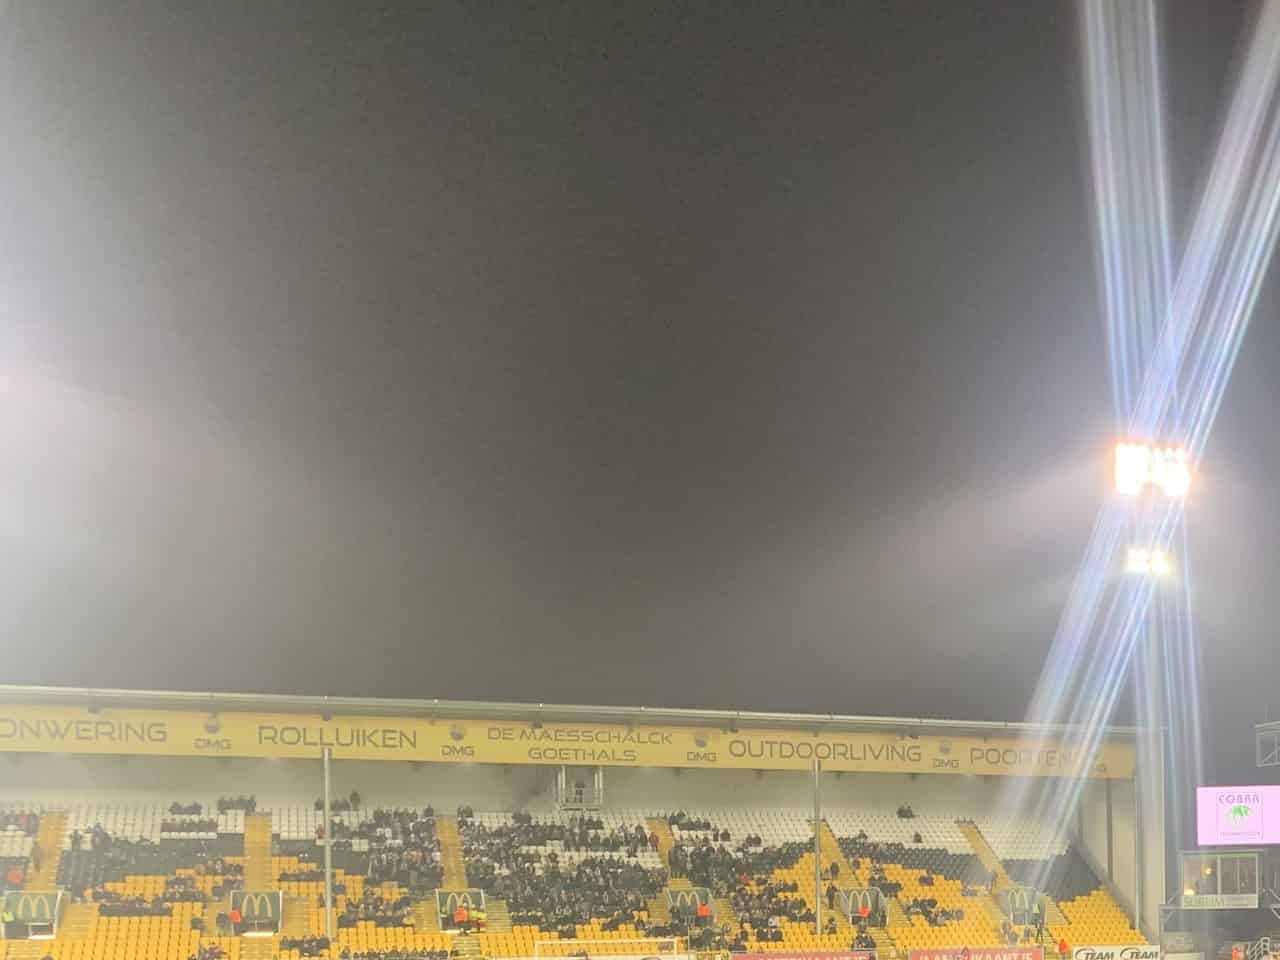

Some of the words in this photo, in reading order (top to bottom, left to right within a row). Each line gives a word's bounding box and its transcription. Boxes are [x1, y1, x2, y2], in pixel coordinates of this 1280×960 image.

[257, 725, 418, 749] ROLLUIKEN
[487, 727, 515, 741] DE
[518, 728, 673, 745] MAESSCHALCK
[440, 744, 475, 757] DMG
[527, 747, 638, 762] GOETHALS
[686, 751, 718, 762] DMG
[727, 739, 922, 763] OUTDOORLIVING
